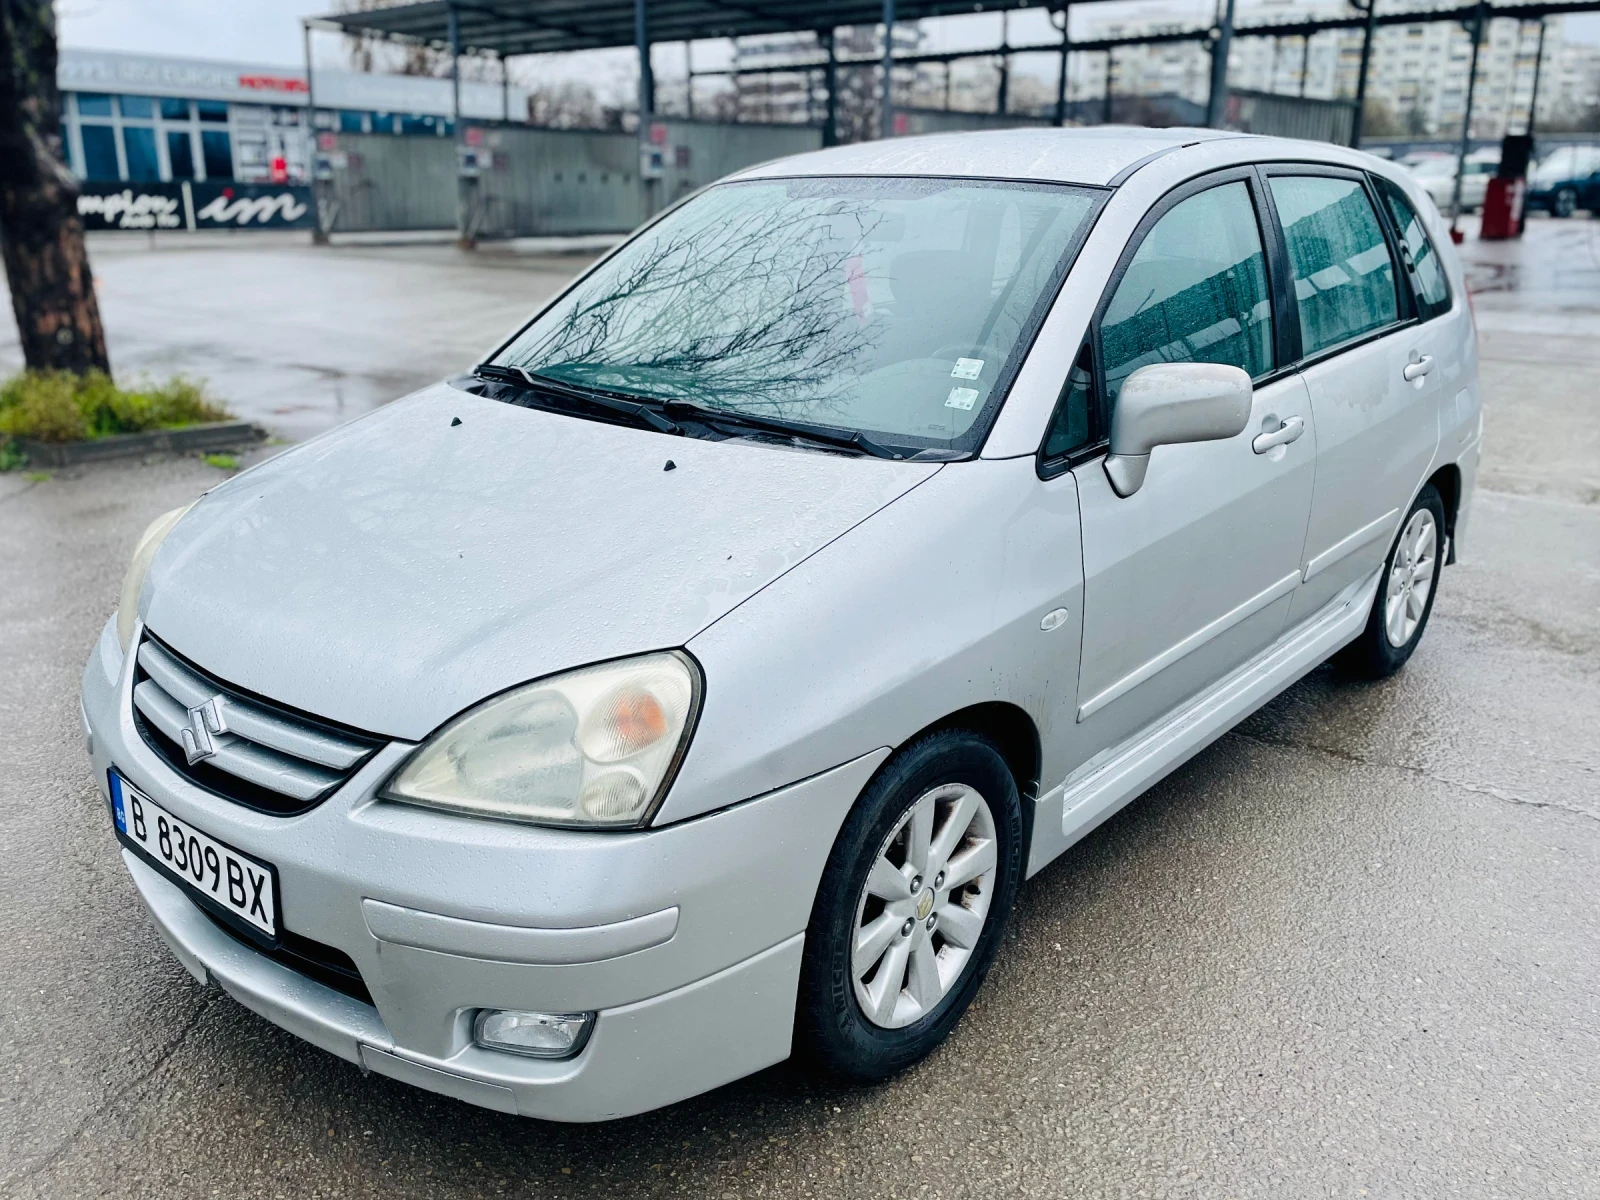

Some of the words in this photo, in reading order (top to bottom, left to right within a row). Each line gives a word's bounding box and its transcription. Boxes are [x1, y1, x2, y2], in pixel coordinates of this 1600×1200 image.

[117, 807, 125, 823] BG
[130, 794, 147, 842] B
[157, 815, 220, 892] 8309
[226, 855, 268, 924] BX
